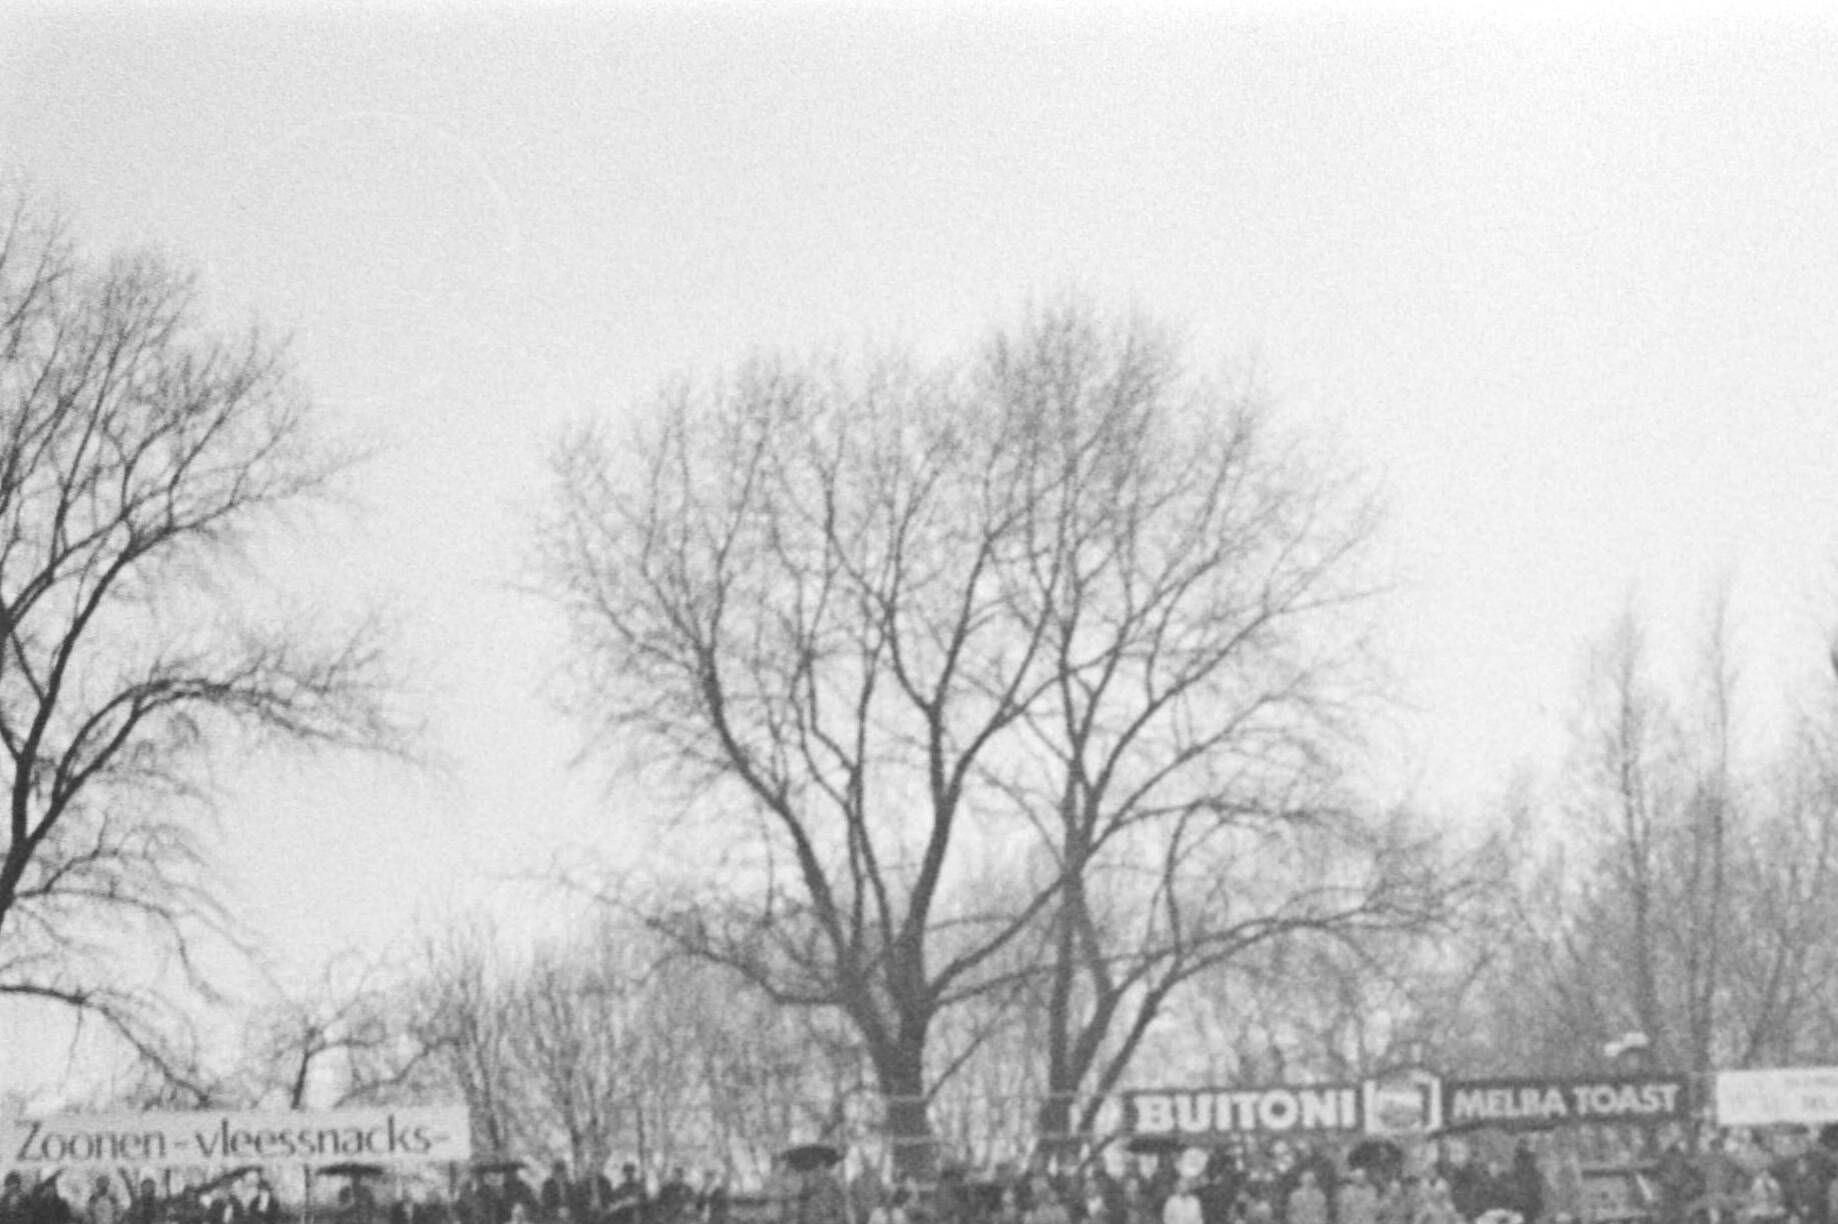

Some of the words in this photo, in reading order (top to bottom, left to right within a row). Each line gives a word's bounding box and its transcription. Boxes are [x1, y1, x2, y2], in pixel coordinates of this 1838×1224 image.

[1135, 1089, 1356, 1133] BUITONI
[1453, 1088, 1567, 1119] MELBA
[1572, 1083, 1679, 1114] TOAST
[16, 1118, 166, 1162] Zoonen
